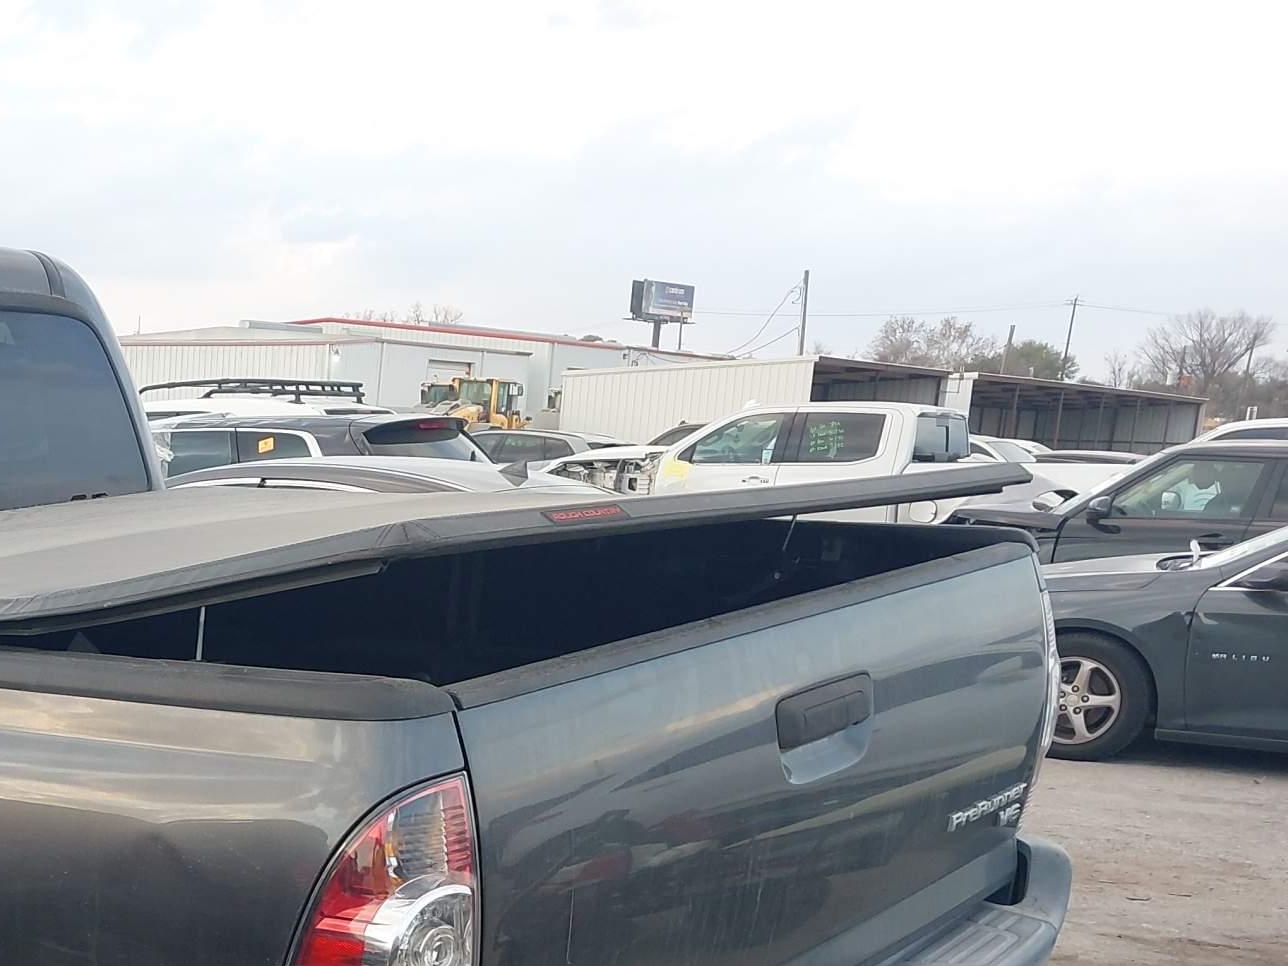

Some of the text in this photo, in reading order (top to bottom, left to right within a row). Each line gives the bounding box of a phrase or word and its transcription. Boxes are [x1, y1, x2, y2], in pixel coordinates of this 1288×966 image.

[1211, 652, 1271, 662] MALIBU
[947, 782, 1028, 832] PreRunner
[998, 803, 1022, 827] V6
